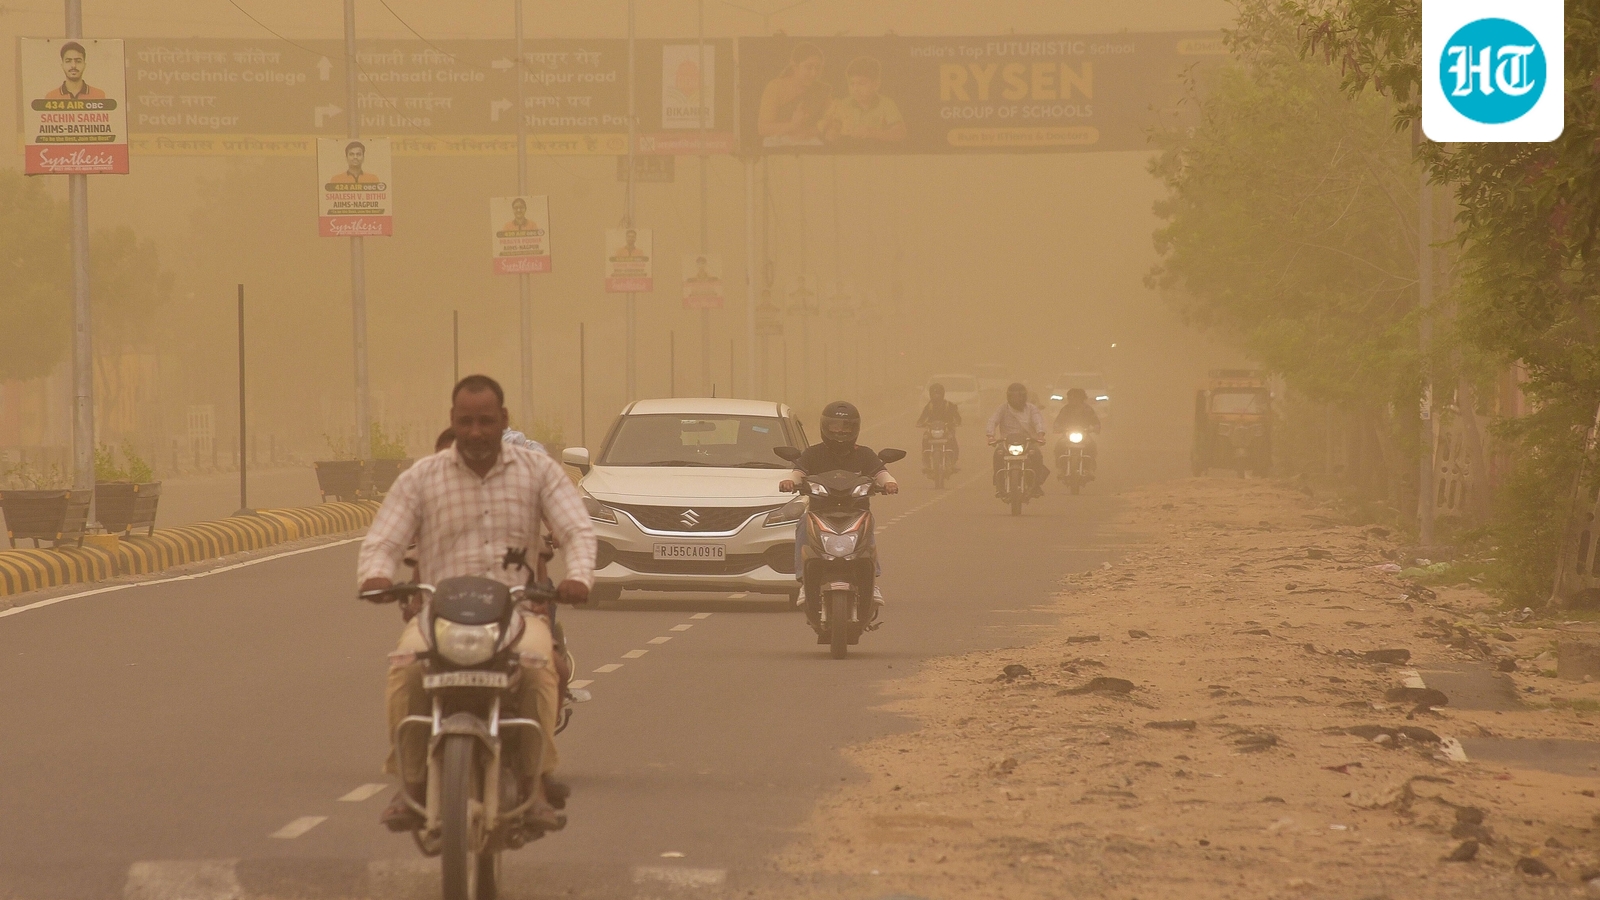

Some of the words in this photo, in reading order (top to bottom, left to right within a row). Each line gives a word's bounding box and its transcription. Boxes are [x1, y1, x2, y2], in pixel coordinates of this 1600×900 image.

[910, 43, 956, 59] India's
[958, 45, 984, 61] Top
[986, 40, 1086, 57] FUTURISTIC
[1088, 43, 1136, 56] School
[137, 69, 239, 85] Polytechnic
[241, 69, 307, 86] College
[435, 69, 486, 82] Circle
[577, 70, 617, 83] road
[939, 60, 1094, 102] RYSEN
[45, 101, 65, 109] 434
[67, 101, 84, 109] AIR
[138, 91, 175, 108] पटेल
[180, 95, 218, 108] नगर
[40, 113, 75, 123] SACHIN
[77, 112, 109, 123] SARAN
[940, 106, 995, 120] GROUP
[997, 105, 1020, 119] OF
[1022, 104, 1094, 119] SCHOOLS
[39, 124, 112, 133] AIIMS-BATHINDA
[138, 113, 182, 126] Patel
[185, 113, 240, 129] Nagar
[389, 115, 432, 128] Lines
[956, 132, 980, 142] Run
[981, 132, 997, 145] by
[1046, 130, 1089, 141] Doctors
[40, 148, 114, 171] Synthesis
[330, 218, 383, 236] Synthesis
[661, 546, 723, 557] RJ55CA0916
